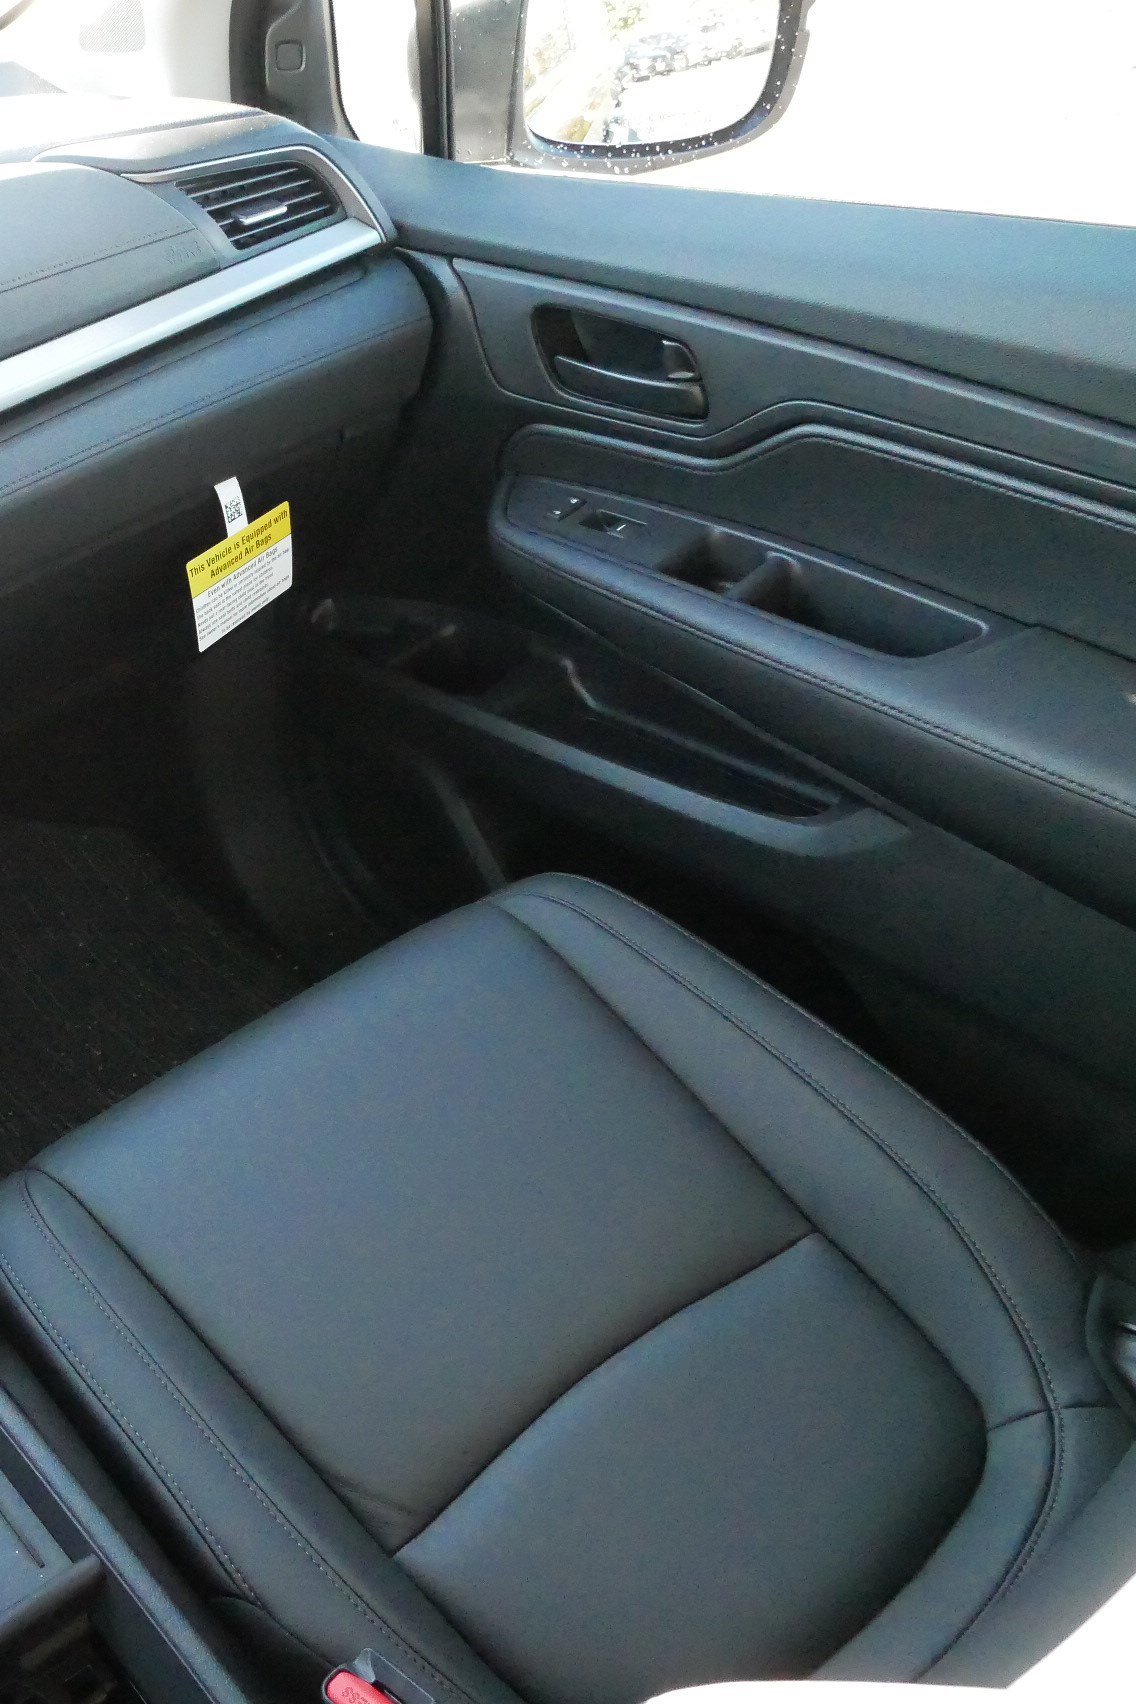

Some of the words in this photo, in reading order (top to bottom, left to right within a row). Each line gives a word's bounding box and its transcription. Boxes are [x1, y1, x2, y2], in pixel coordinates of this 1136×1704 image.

[190, 563, 205, 578] This
[206, 546, 232, 567] Vehicle
[234, 541, 240, 551] is
[242, 519, 272, 545] Equipped
[274, 509, 287, 524] with
[210, 552, 243, 578] Advanced
[245, 544, 254, 557] Air
[256, 532, 272, 549] Bags
[208, 584, 220, 597] Even
[233, 560, 256, 581] Advanced
[257, 554, 265, 566] Air
[265, 547, 278, 561] Bags
